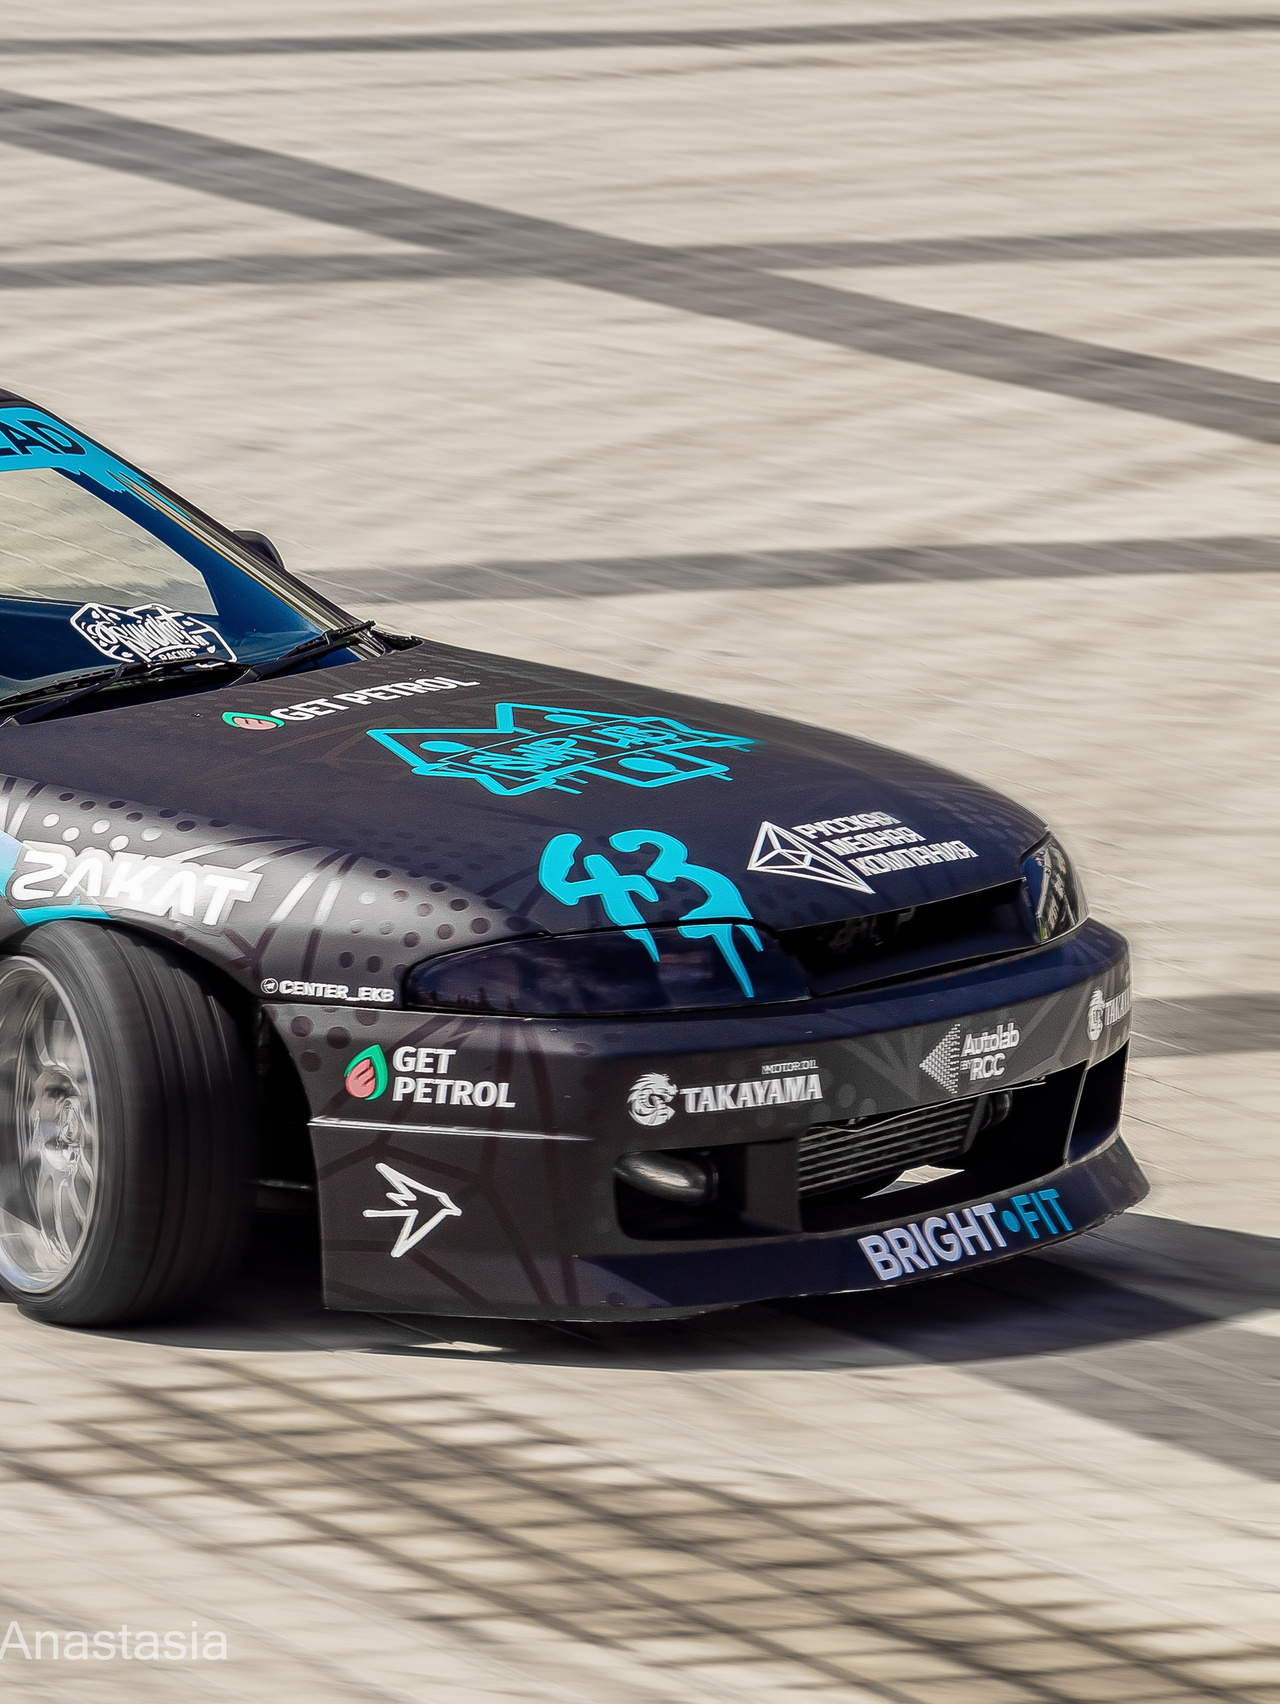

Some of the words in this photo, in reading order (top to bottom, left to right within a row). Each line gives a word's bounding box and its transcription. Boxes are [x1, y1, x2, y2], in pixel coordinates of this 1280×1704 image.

[270, 696, 351, 723] GET
[346, 676, 481, 707] PETROL
[790, 811, 903, 840] РУССКАЯ
[820, 826, 927, 857] МЕДНАЯ
[847, 839, 980, 877] КОМПАНИЯ
[537, 828, 766, 998] 43
[278, 980, 395, 1003] CENTER_EKB
[960, 1022, 1020, 1058] Autolab
[392, 1045, 457, 1074] GET
[969, 1052, 1006, 1081] RCC
[392, 1076, 516, 1108] PETROL
[679, 1073, 824, 1114] TAKAYAMA
